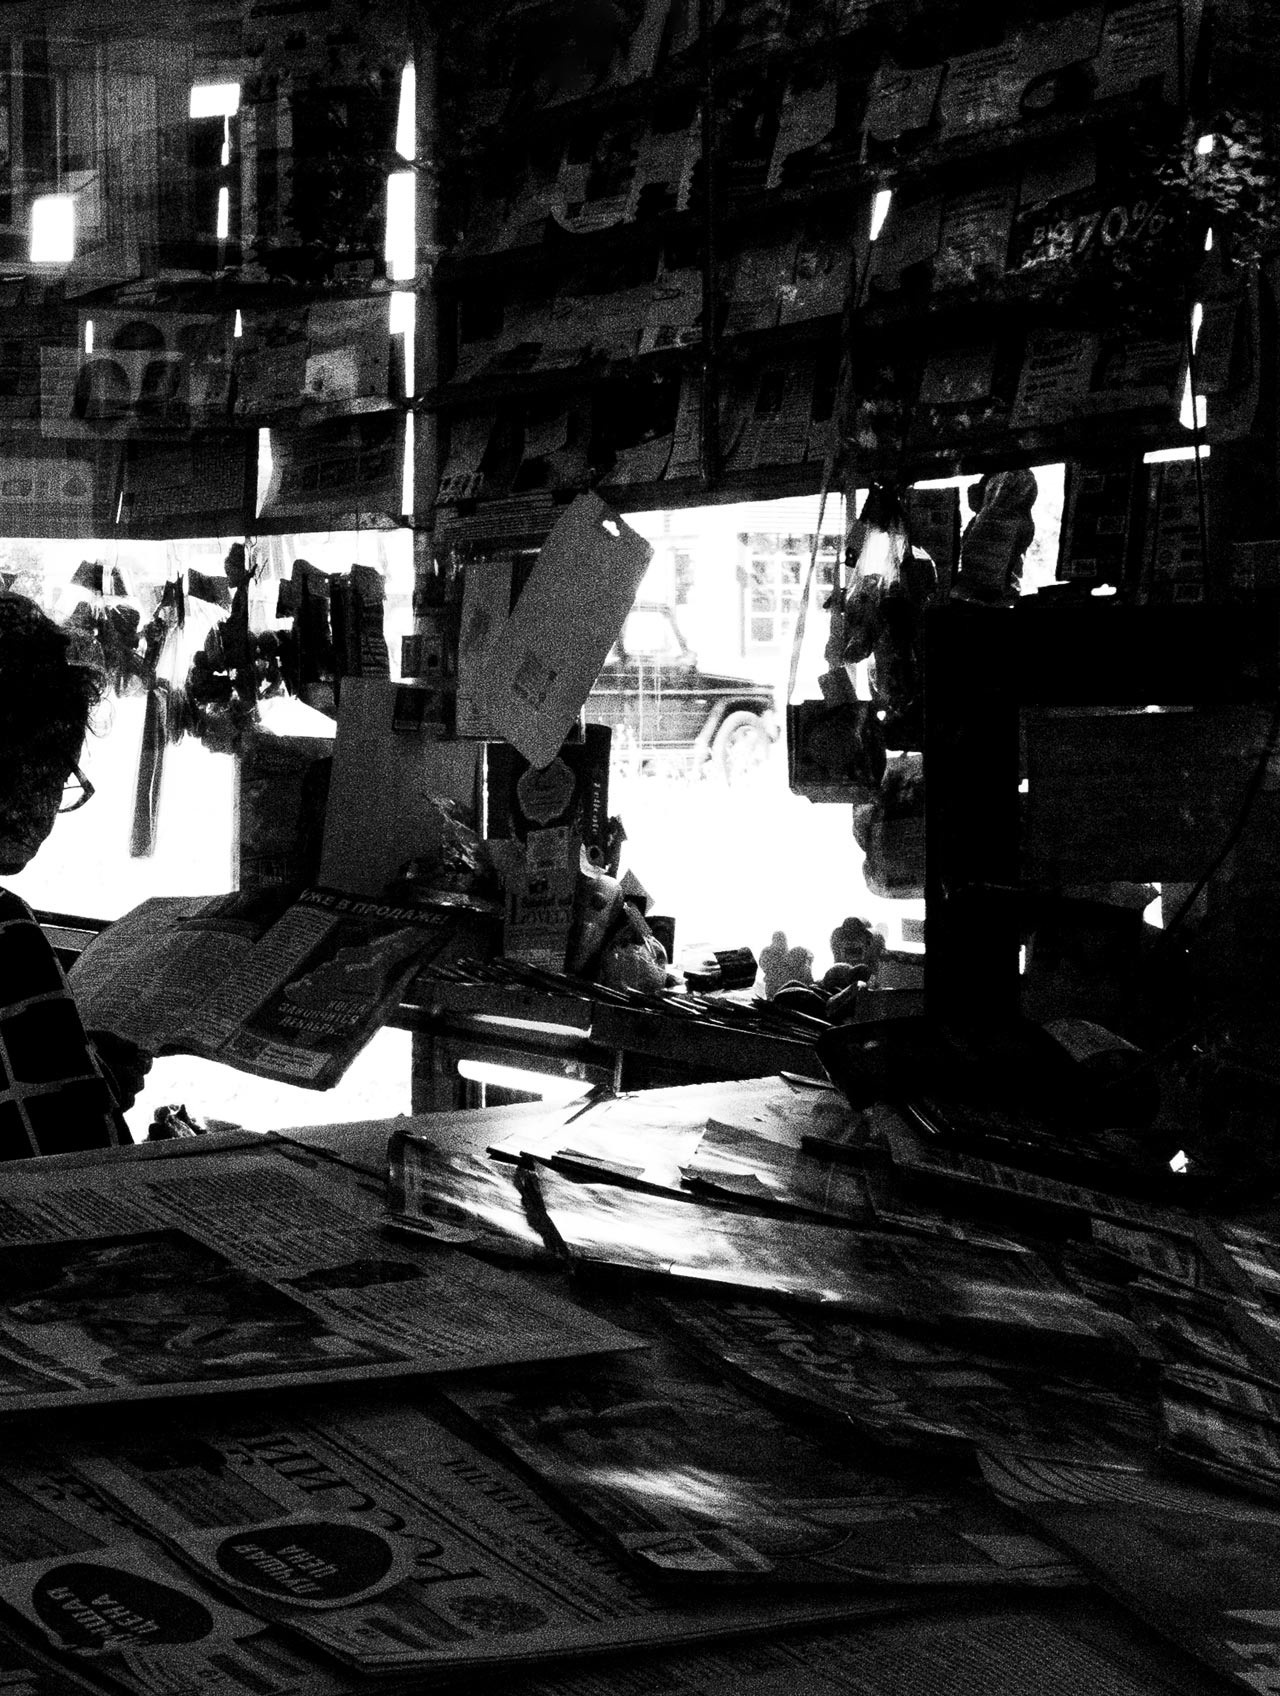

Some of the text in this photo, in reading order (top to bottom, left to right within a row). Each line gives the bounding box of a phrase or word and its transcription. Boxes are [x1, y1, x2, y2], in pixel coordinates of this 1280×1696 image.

[336, 898, 350, 910] В
[351, 901, 451, 926] ПРОДАЖЕ!
[231, 1542, 324, 1594] ЛУЧШАЯ
[278, 1543, 341, 1576] ЦЕНА
[98, 1592, 161, 1635] ЦЕНА
